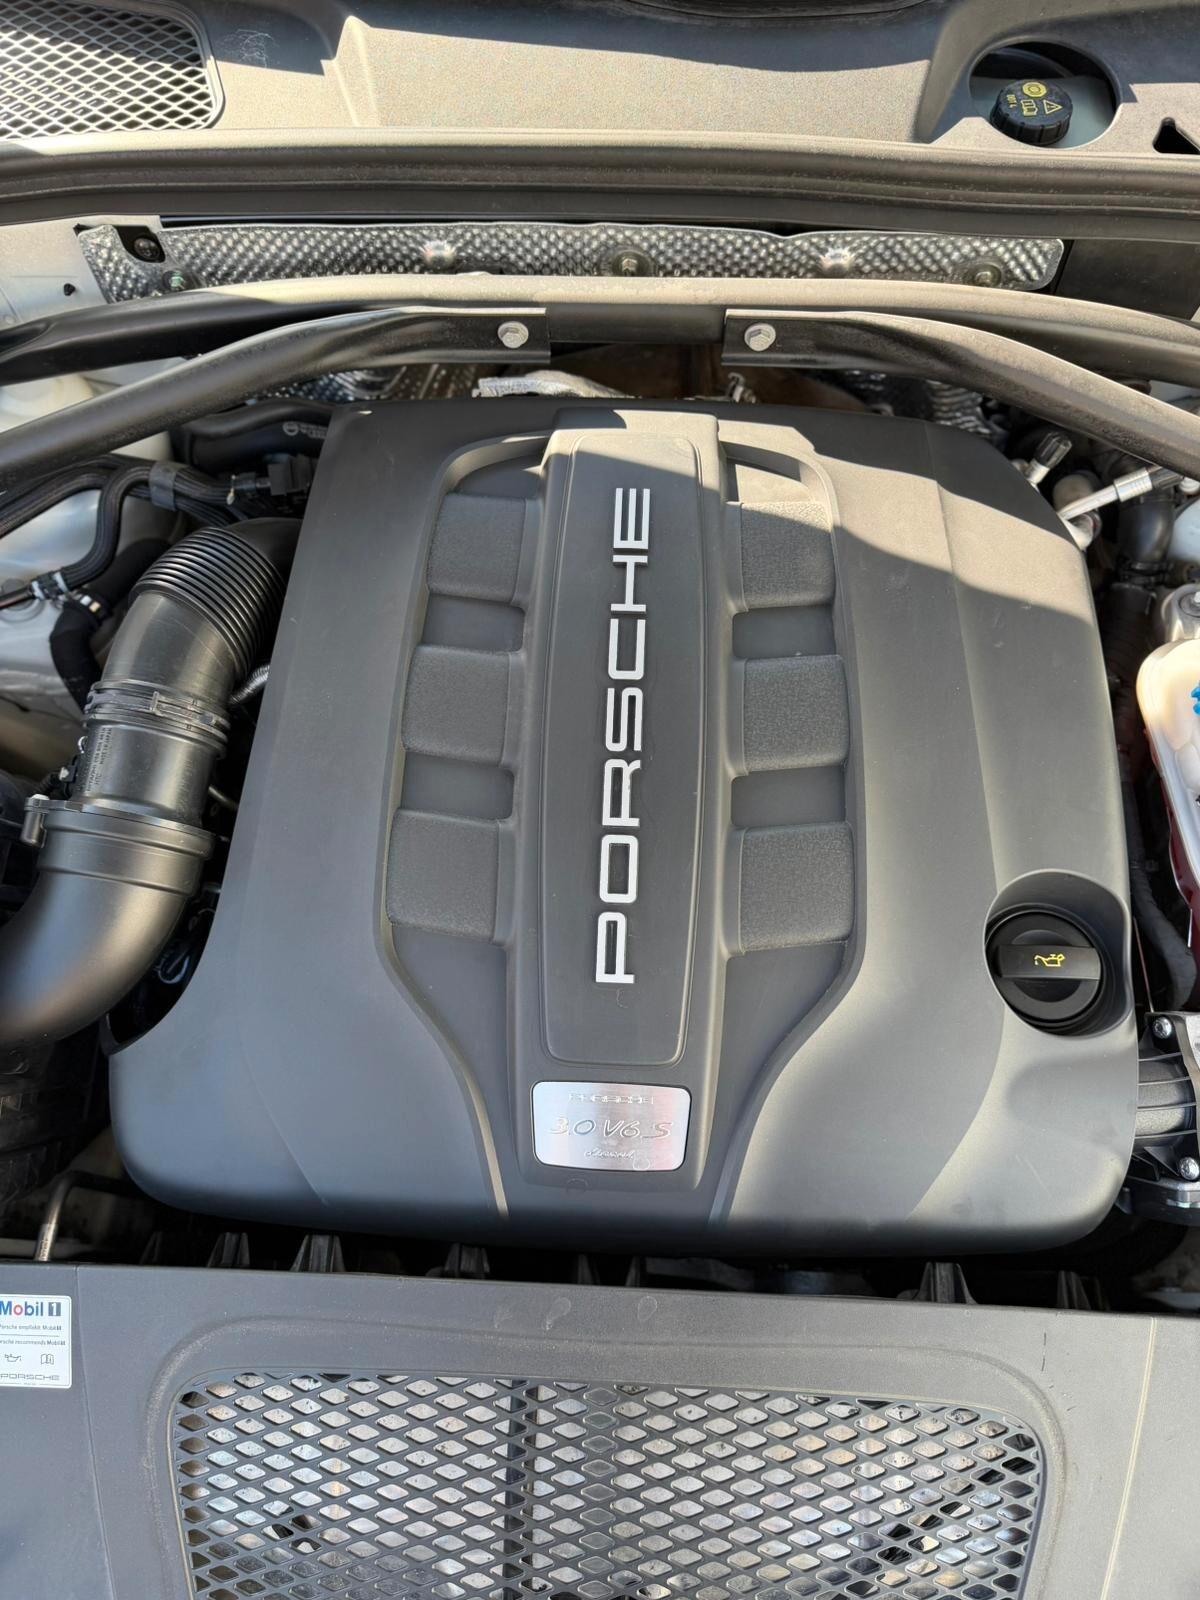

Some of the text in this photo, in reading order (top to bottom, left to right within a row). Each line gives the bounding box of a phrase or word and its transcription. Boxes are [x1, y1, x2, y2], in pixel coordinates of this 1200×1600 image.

[595, 487, 651, 984] PORSCHE
[602, 1119, 641, 1138] V6
[641, 1121, 674, 1140] S
[0, 1300, 60, 1316] Mobil 1
[0, 1373, 60, 1381] PORSCHE
